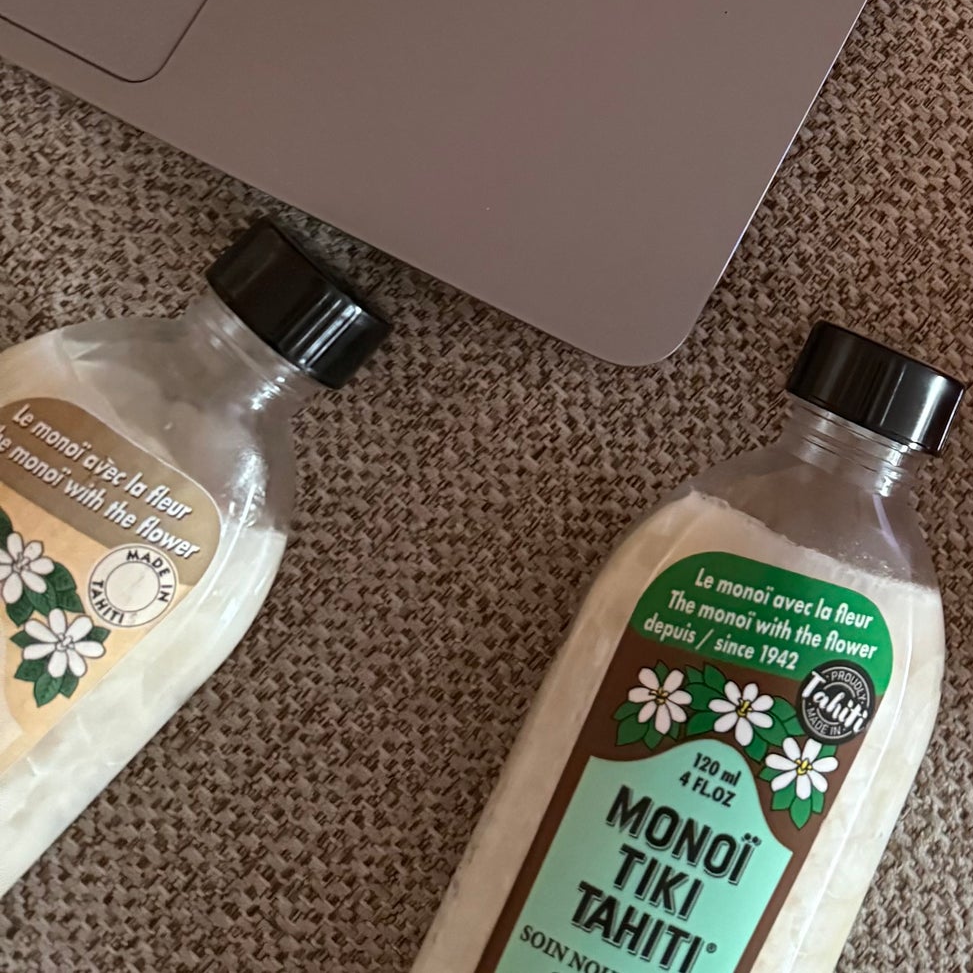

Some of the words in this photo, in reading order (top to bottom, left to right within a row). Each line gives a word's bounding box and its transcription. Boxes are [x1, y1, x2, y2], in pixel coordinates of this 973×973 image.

[12, 403, 34, 427] Le
[31, 420, 91, 462] monoï
[125, 472, 147, 498] la
[145, 484, 193, 520] fleur
[8, 449, 72, 487] monoï
[64, 478, 107, 514] with
[103, 501, 137, 528] the
[136, 518, 201, 559] flower
[90, 579, 125, 624] TAHITI
[126, 549, 172, 577] MADE
[160, 584, 172, 603] IN
[694, 567, 714, 589] Le
[716, 577, 773, 604] monoï
[773, 594, 813, 616] avec
[814, 597, 833, 620] la
[834, 601, 874, 630] fleur
[644, 612, 697, 643] depuis
[714, 634, 755, 659] since
[759, 644, 799, 671] 1942
[667, 589, 696, 614] The
[698, 600, 756, 630] monoï
[755, 615, 793, 640] with
[794, 624, 822, 647] the
[824, 630, 878, 659] flower
[802, 670, 868, 733] Tahiti
[831, 670, 867, 701] PROUDLY
[807, 707, 829, 735] MADE
[679, 771, 691, 787] 4
[691, 778, 737, 808] FL.OZ
[692, 752, 720, 778] 120
[722, 769, 742, 787] ml
[605, 784, 762, 886] MONOÏ
[613, 843, 703, 921] TIKI
[520, 925, 569, 962] SOIN
